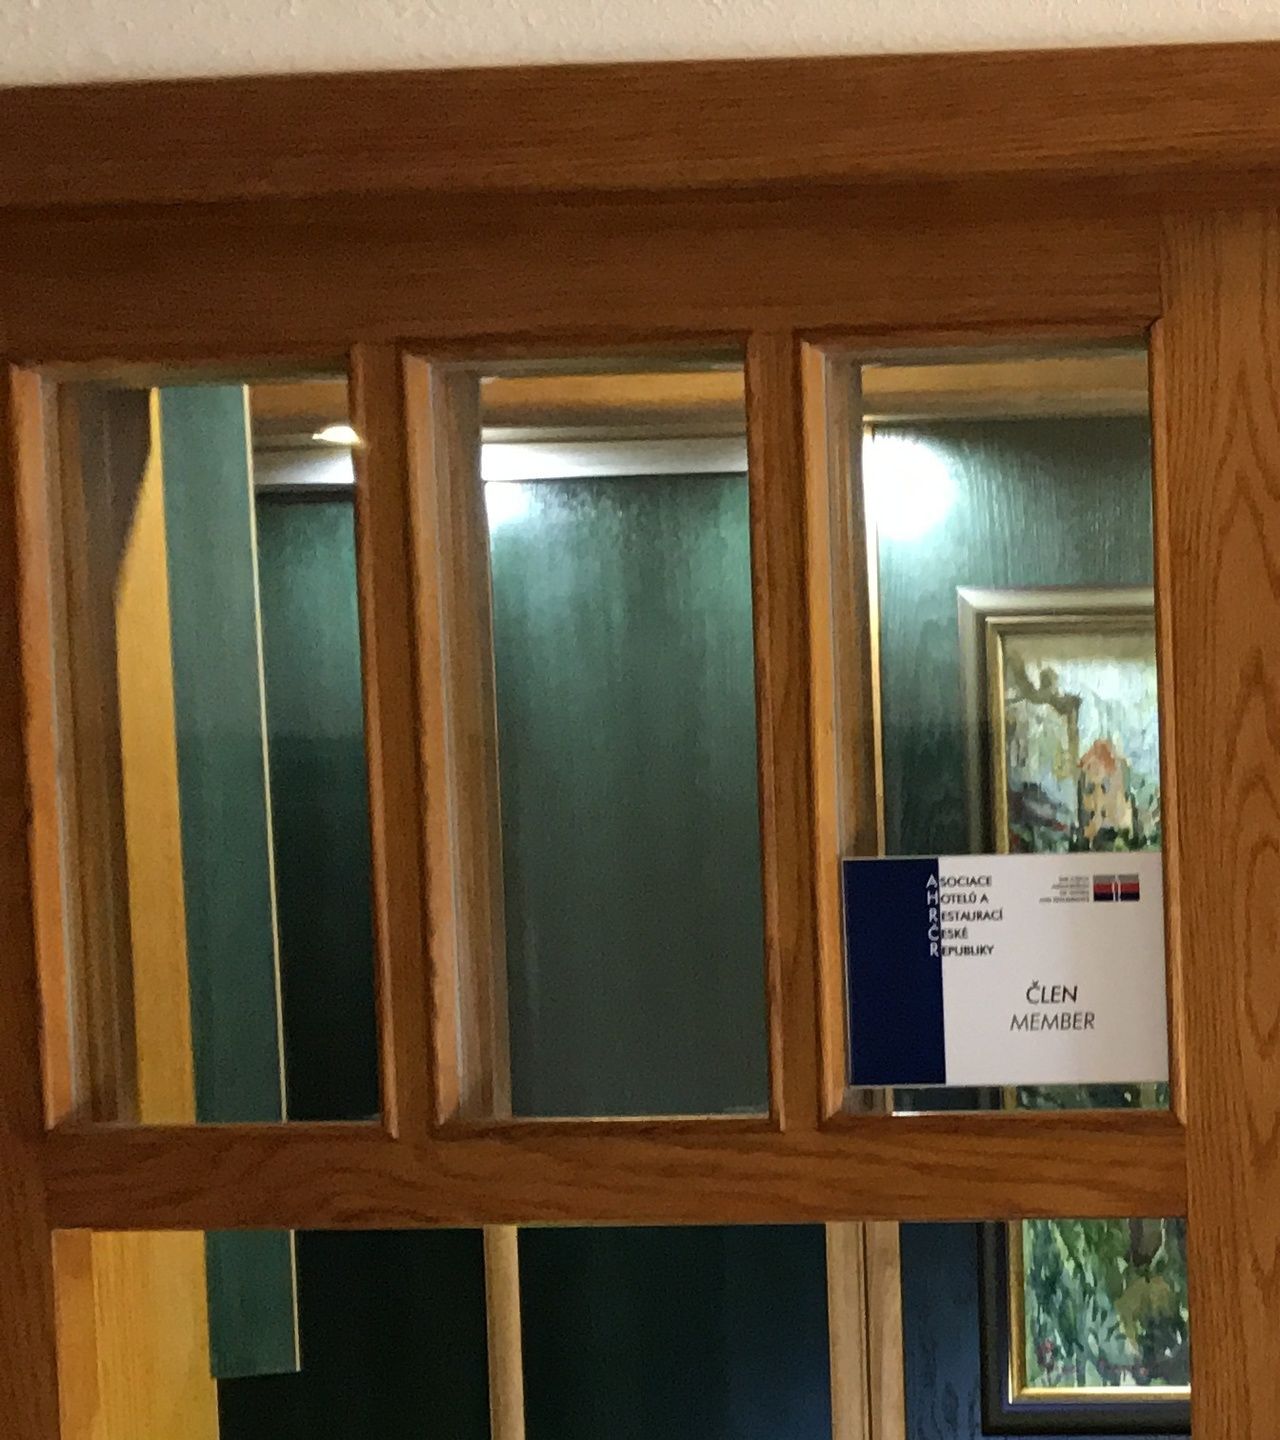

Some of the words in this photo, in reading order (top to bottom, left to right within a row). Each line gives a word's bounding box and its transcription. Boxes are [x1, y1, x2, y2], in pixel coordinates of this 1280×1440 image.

[926, 873, 992, 888] ASOCIACE
[980, 893, 990, 905] A
[929, 907, 1004, 922] RESTAURACÍ
[928, 923, 968, 941] ČESKÉ
[930, 942, 994, 957] REPUBLIKY
[1026, 979, 1078, 1004] ČLEN
[1010, 1012, 1095, 1031] MEMBER
